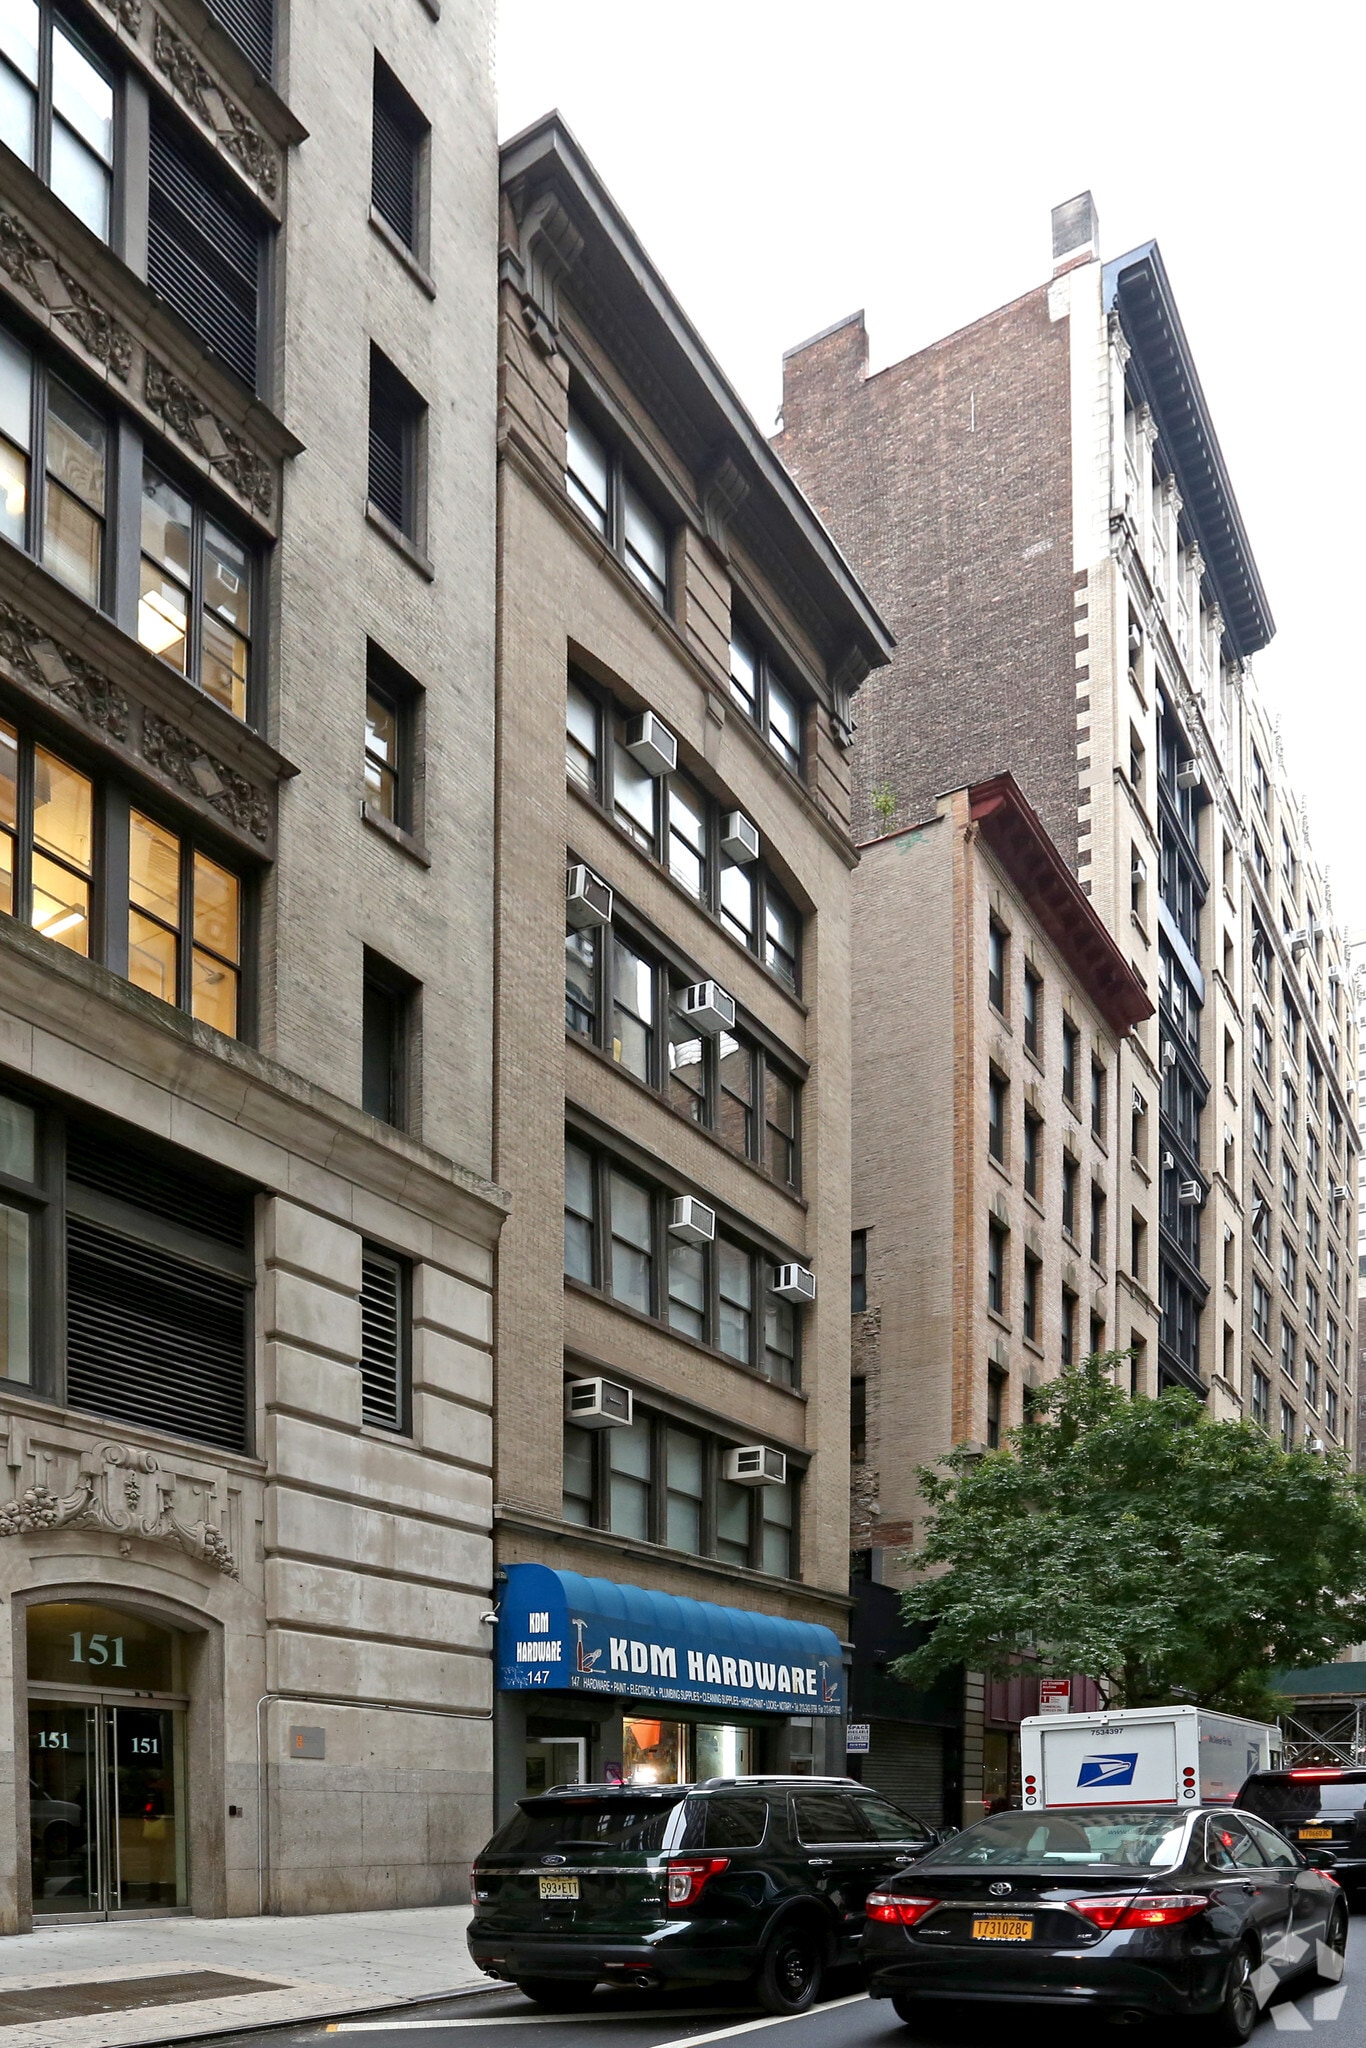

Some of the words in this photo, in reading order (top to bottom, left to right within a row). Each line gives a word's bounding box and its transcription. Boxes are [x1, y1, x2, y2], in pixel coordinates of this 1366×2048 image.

[528, 1612, 549, 1634] KDM
[68, 1631, 128, 1669] 151
[516, 1640, 562, 1662] HARDWARE
[609, 1636, 677, 1679] KDM
[688, 1650, 818, 1696] HARDWARE
[527, 1670, 550, 1685] 147
[571, 1676, 580, 1687] 147
[583, 1677, 611, 1692] HARDWARE
[613, 1682, 627, 1693] PAINT
[630, 1683, 656, 1697] ELECTRICAL
[37, 1730, 70, 1750] 151
[1090, 1728, 1124, 1736] 7534397
[131, 1737, 159, 1755] 151
[977, 1921, 1029, 1936] T731028C
